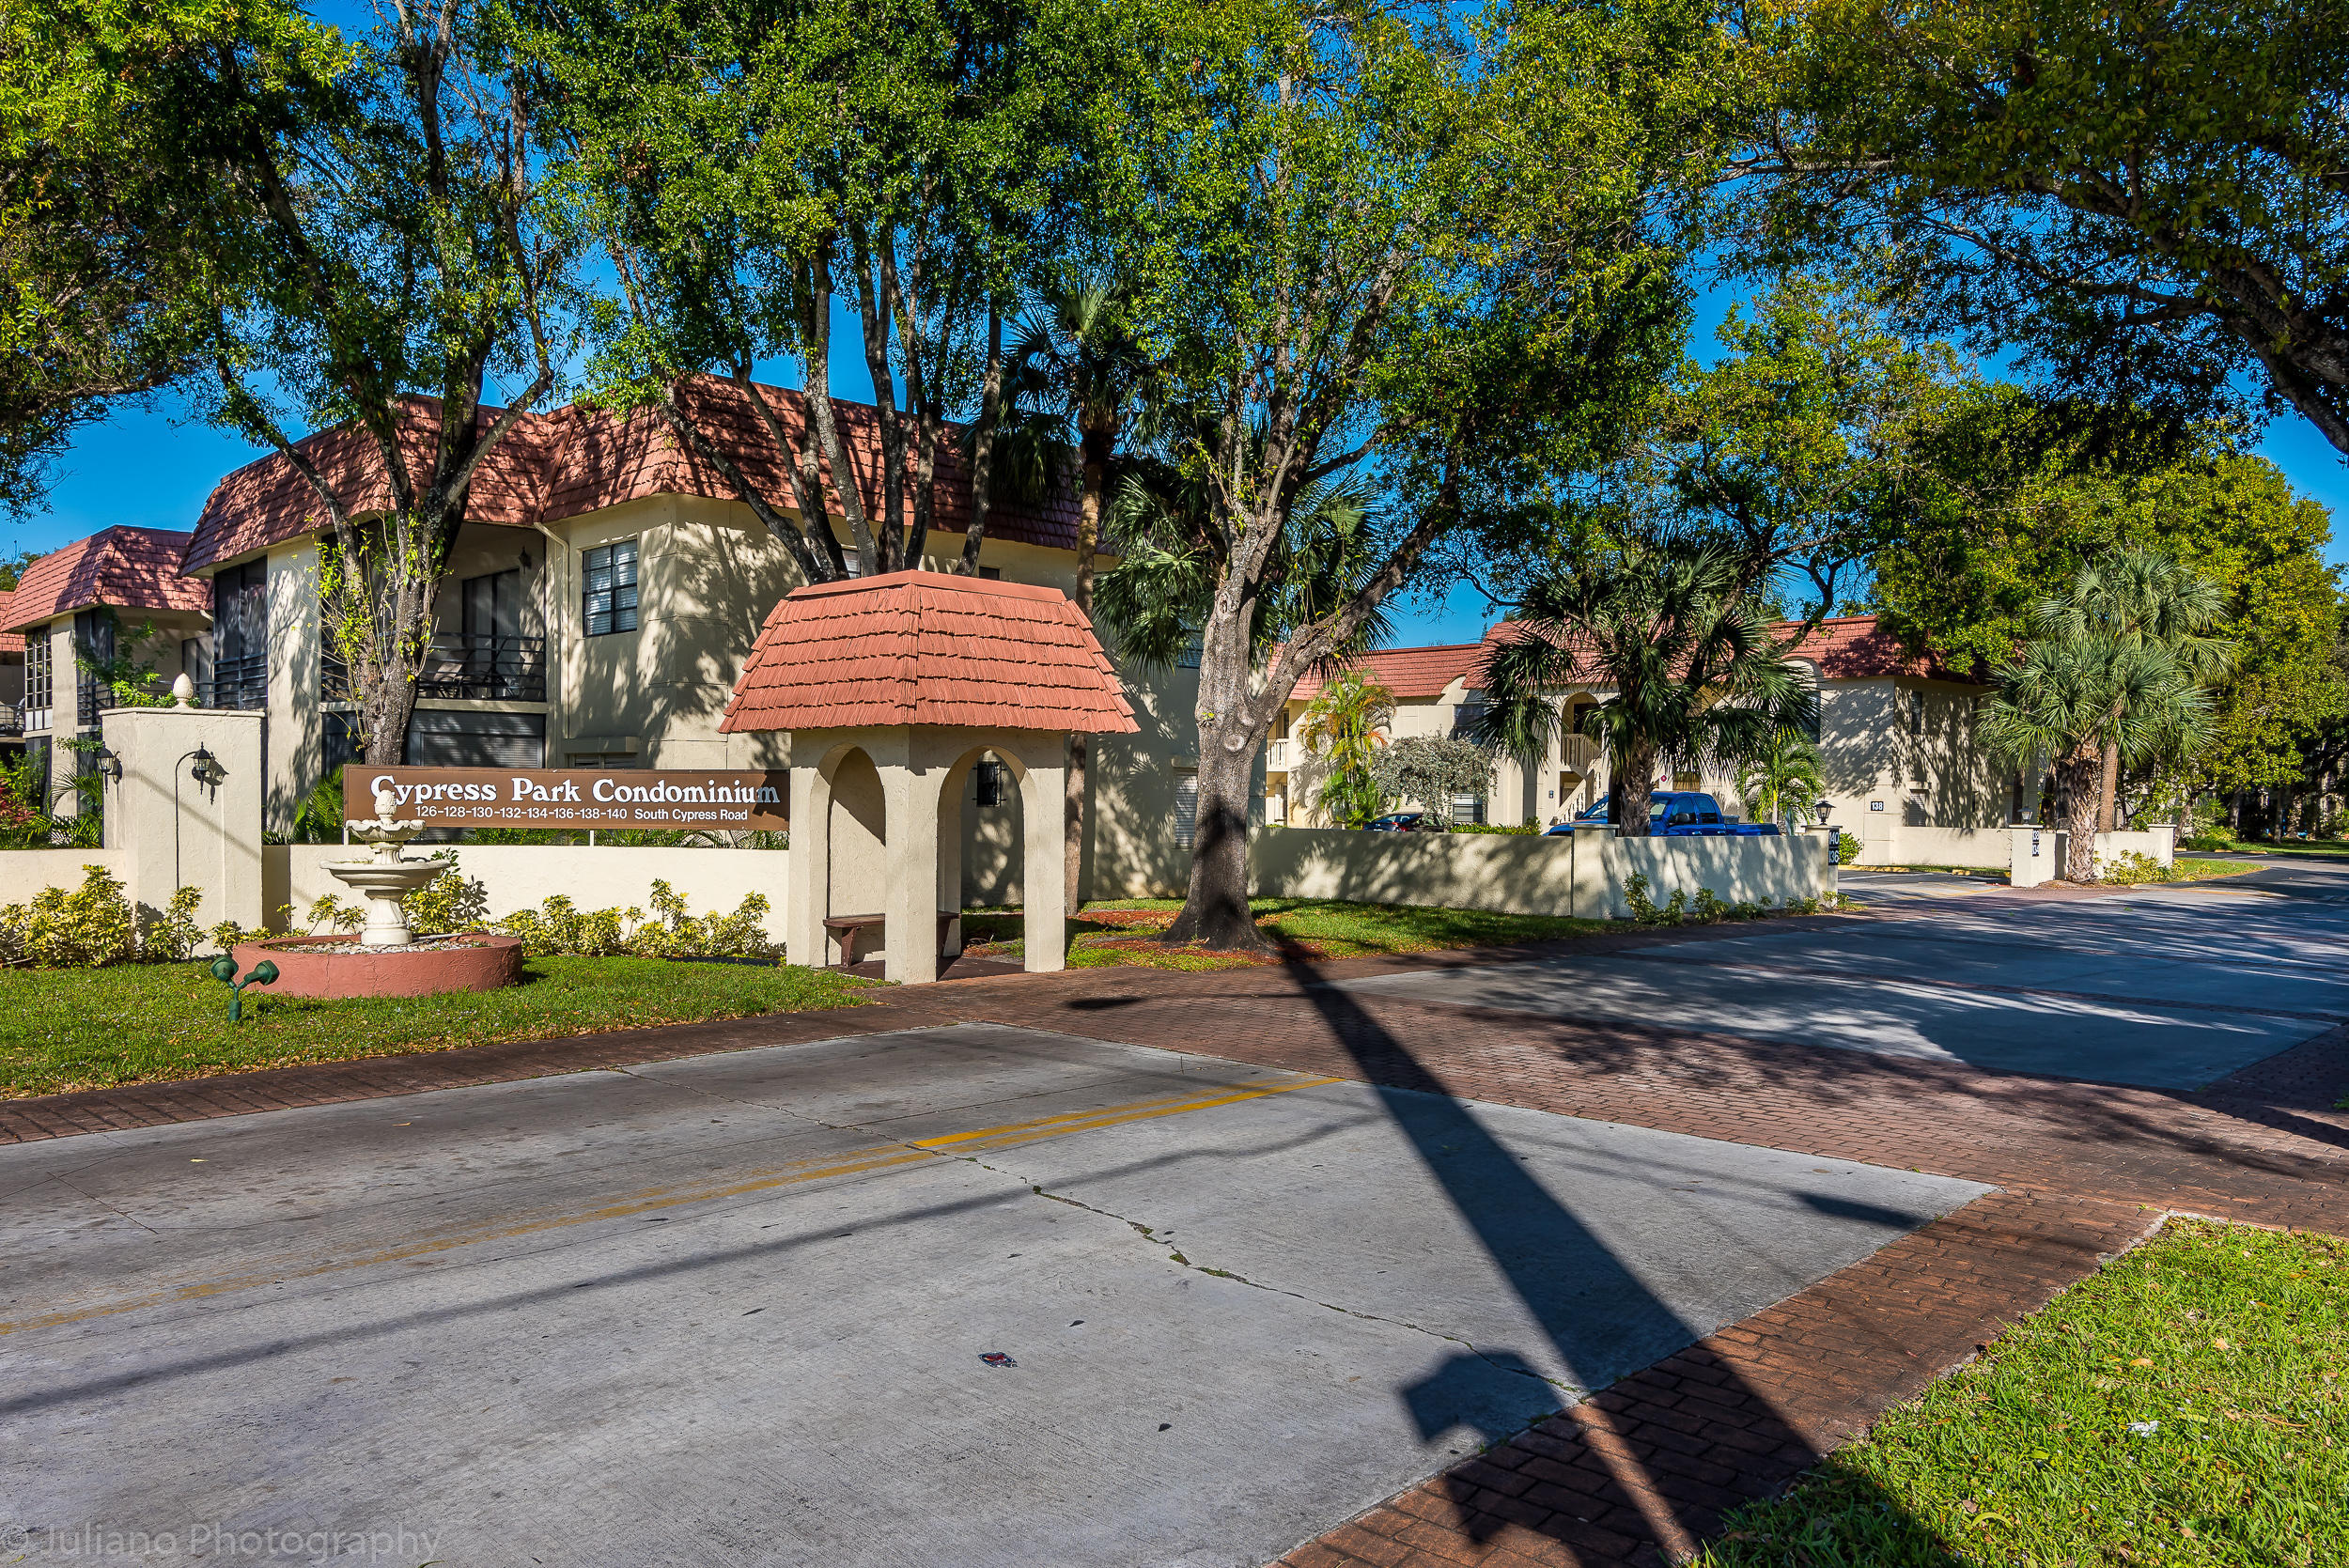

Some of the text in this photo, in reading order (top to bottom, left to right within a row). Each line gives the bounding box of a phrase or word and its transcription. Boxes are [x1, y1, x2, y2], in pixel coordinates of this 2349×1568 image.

[370, 775, 781, 805] Cypress Park Condominium
[1872, 801, 1883, 811] 138
[414, 805, 748, 822] 126-128-130-132-134-136-138-140 South Cypress Road
[1828, 831, 1840, 845] 140
[1828, 849, 1839, 863] 136
